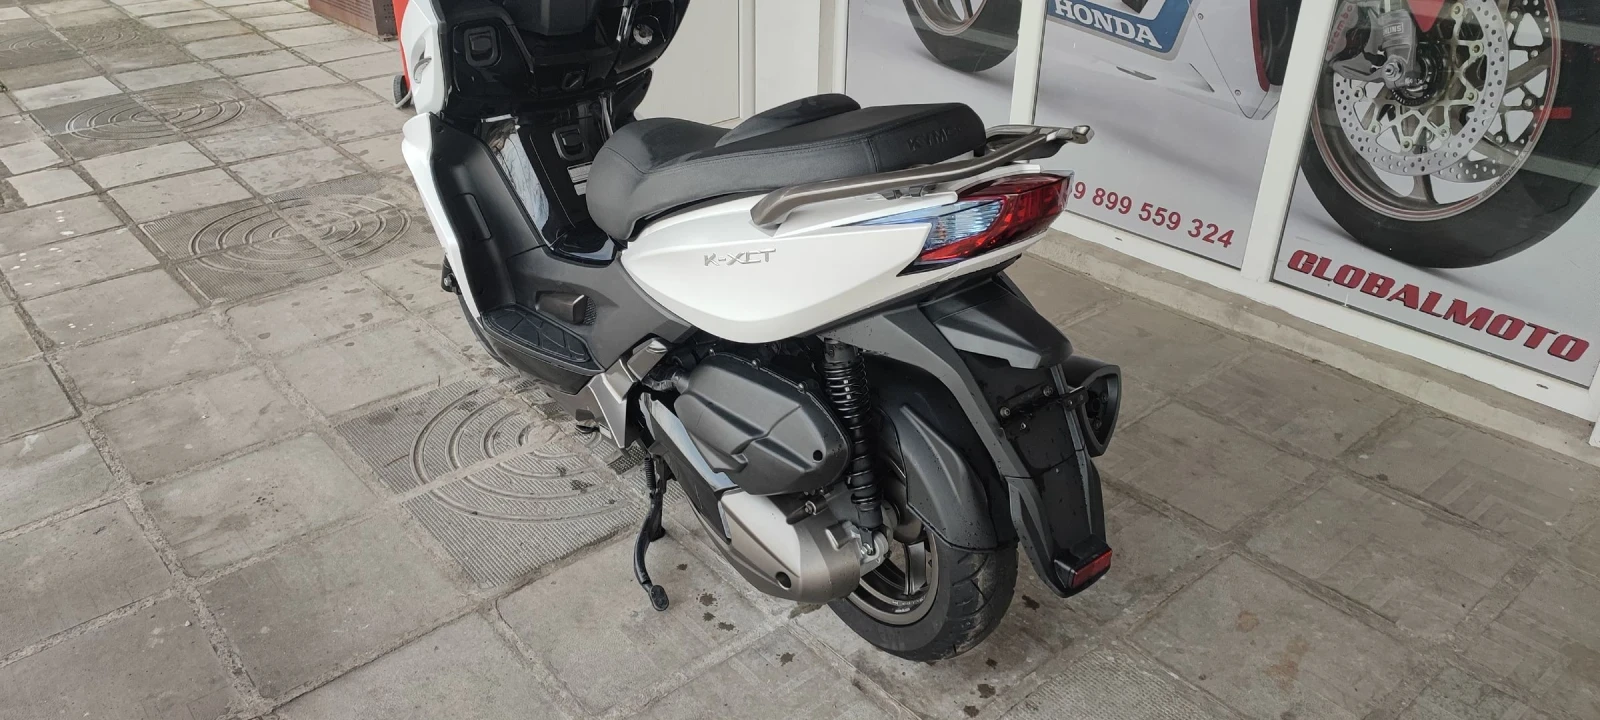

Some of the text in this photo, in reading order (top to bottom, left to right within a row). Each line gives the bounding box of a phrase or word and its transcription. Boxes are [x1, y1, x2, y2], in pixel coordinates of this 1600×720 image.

[1055, 0, 1163, 49] HONDA
[1092, 187, 1133, 215] 899
[1138, 202, 1182, 231] 559
[1187, 218, 1235, 249] 324
[704, 248, 777, 267] K-XCT
[1287, 249, 1590, 362] GLOBALMOTO
